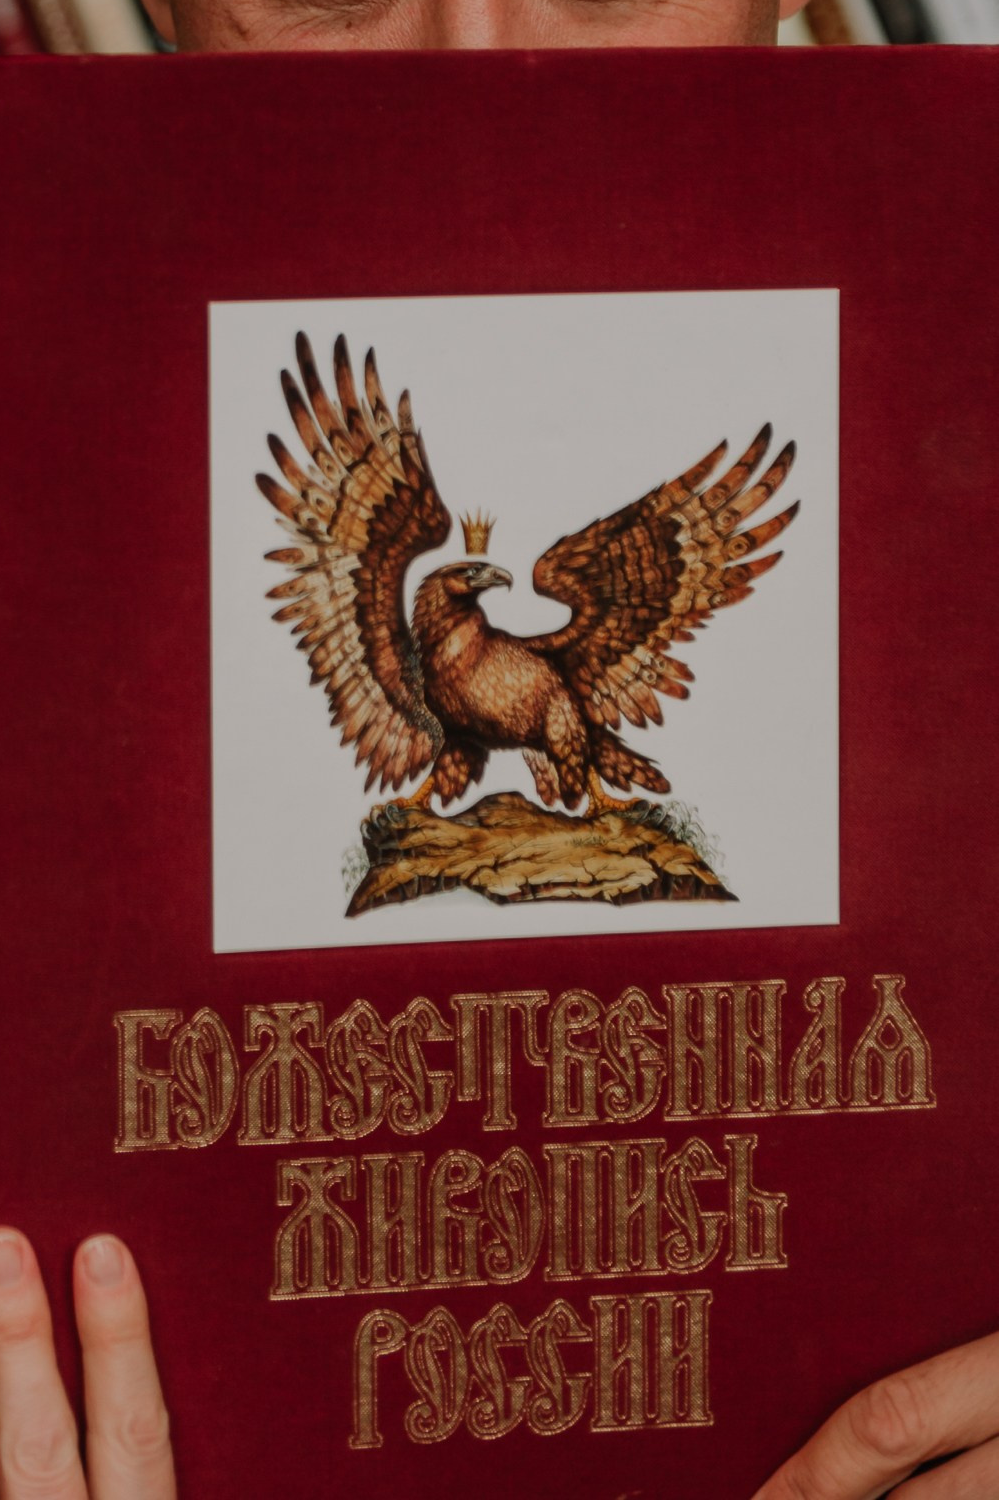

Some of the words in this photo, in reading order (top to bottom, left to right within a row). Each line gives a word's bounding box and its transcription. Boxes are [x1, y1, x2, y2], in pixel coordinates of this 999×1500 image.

[112, 973, 937, 1153] БОЖЕСТВЕННАЯ
[268, 1133, 789, 1301] ЖИВОПИСЬ
[347, 1288, 715, 1450] РОССИИ
